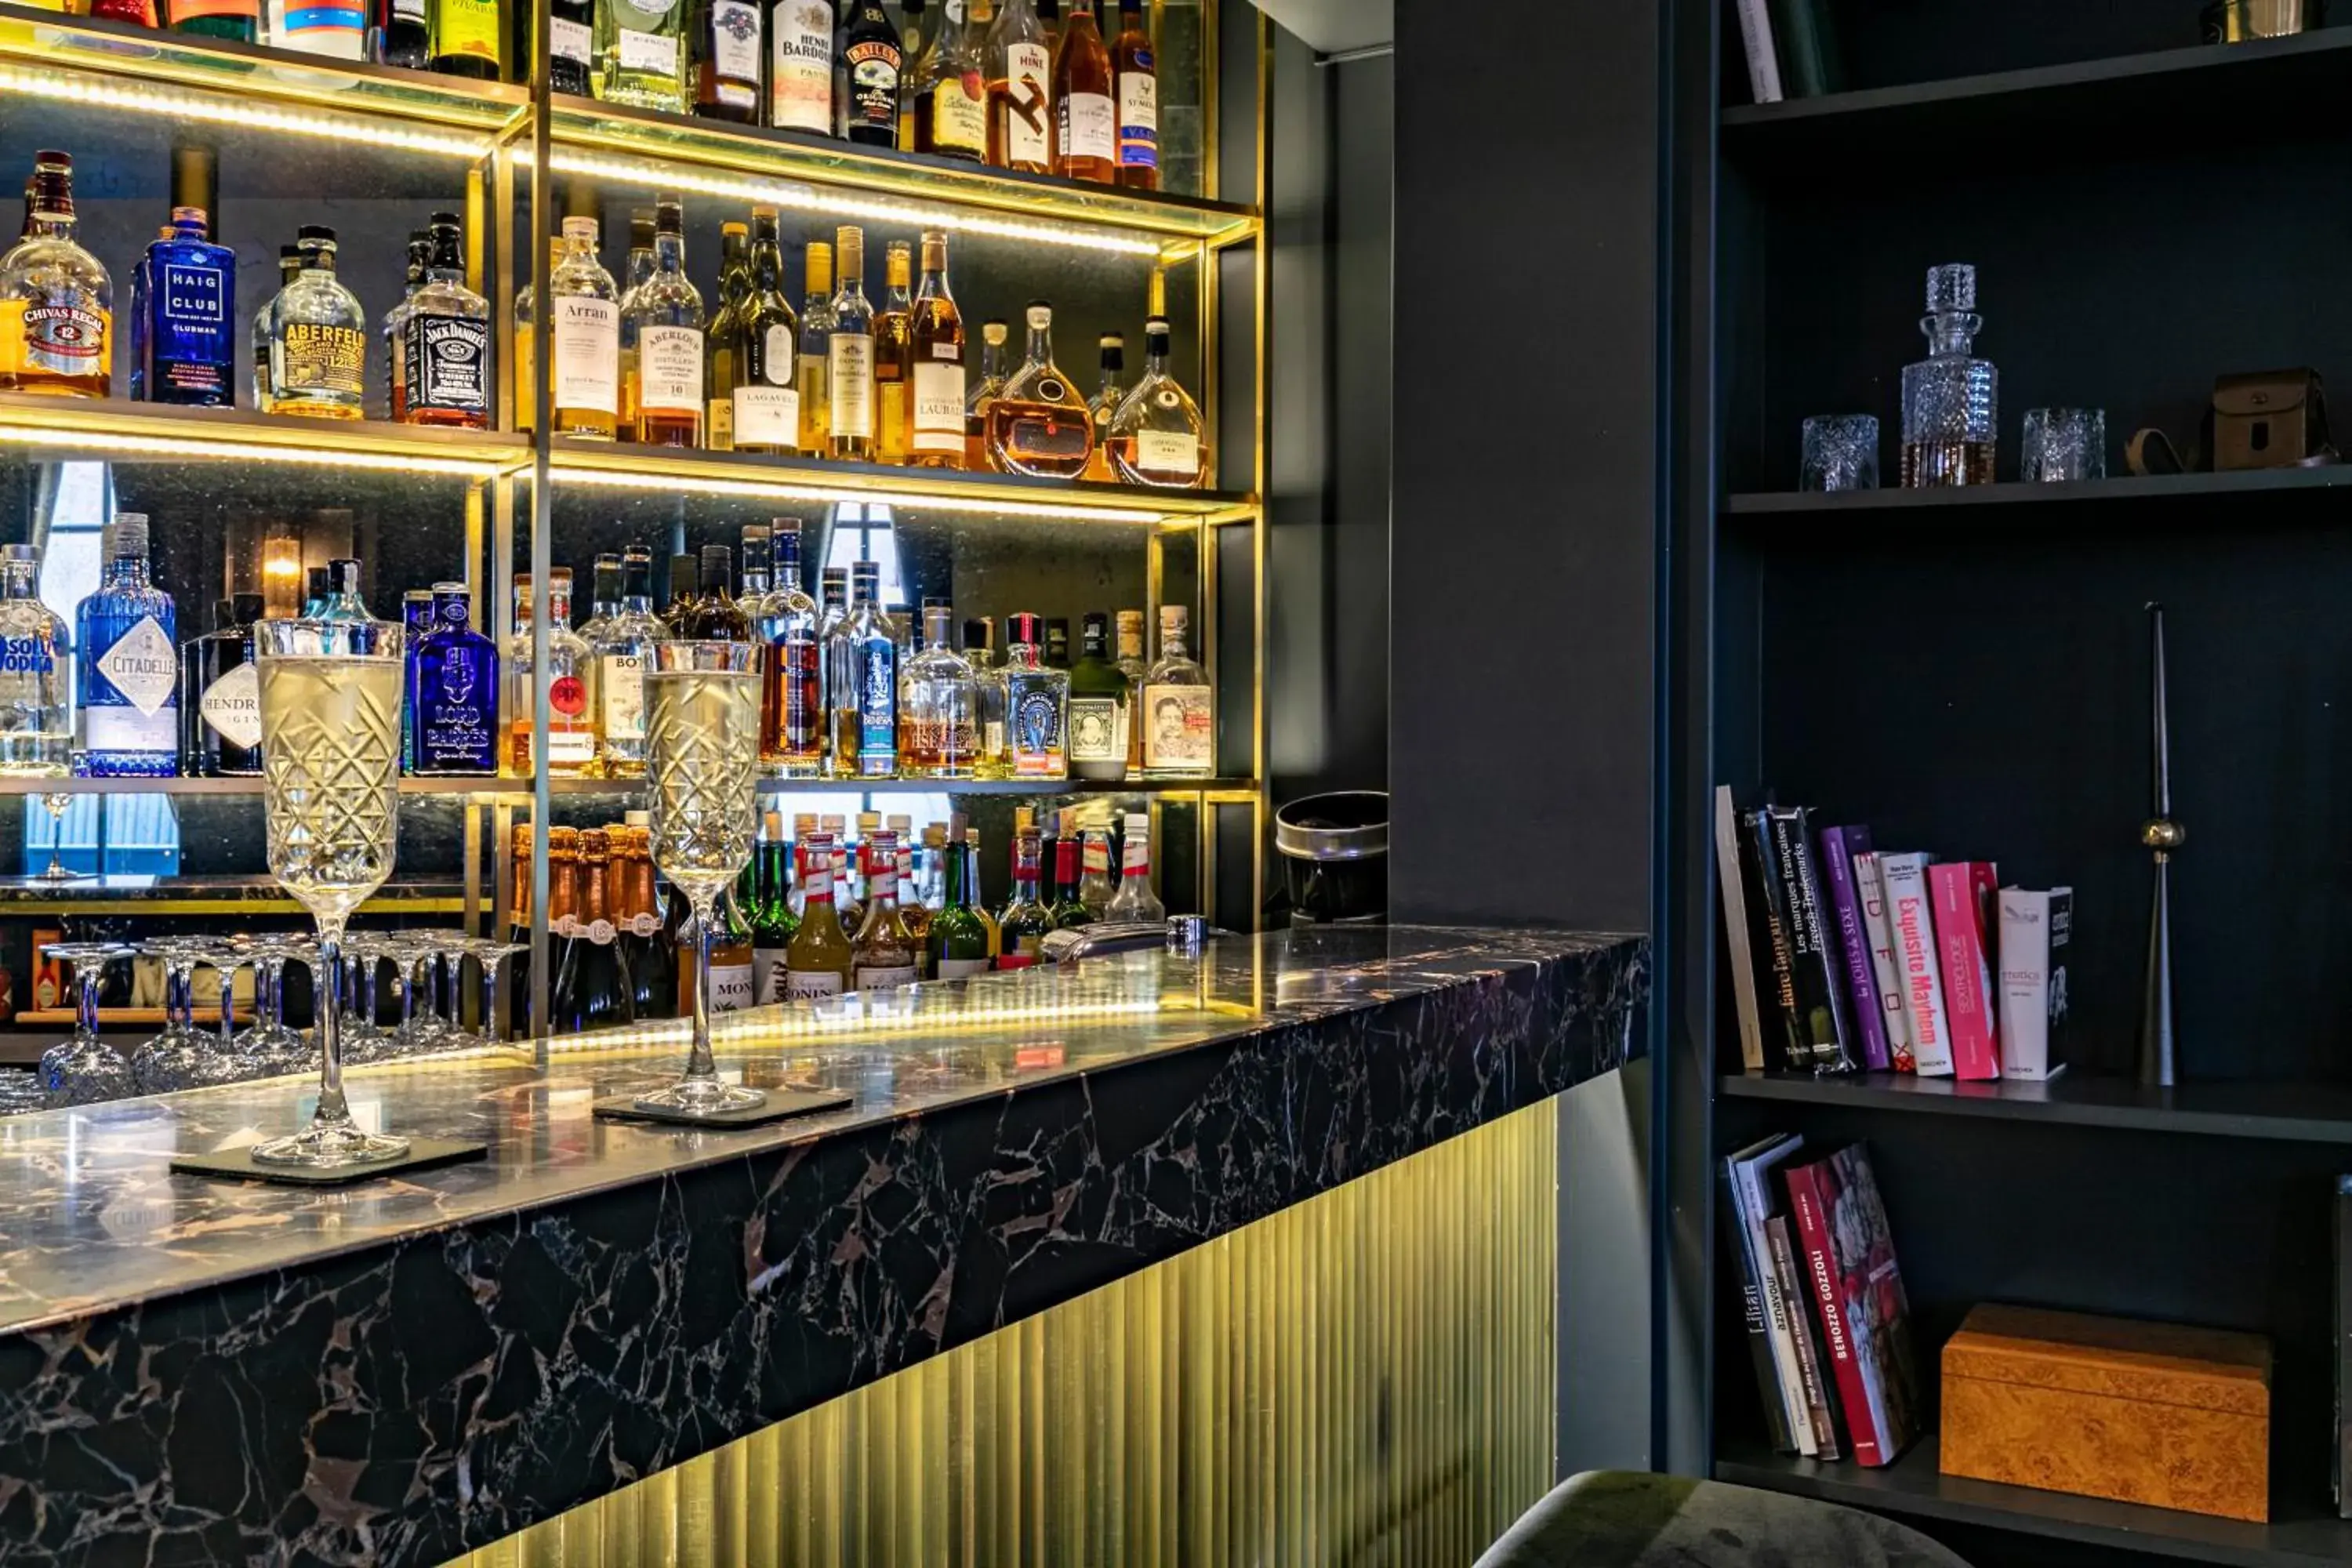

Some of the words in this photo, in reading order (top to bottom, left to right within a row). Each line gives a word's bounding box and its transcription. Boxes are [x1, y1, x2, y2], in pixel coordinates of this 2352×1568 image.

[1021, 56, 1044, 69] HINE
[172, 273, 216, 288] HAIG
[172, 297, 216, 311] CLUB
[566, 304, 608, 320] Arran
[24, 308, 68, 322] CHIVAS
[71, 309, 103, 332] REGAL
[62, 327, 75, 339] 12
[172, 325, 217, 335] CLUBMAN
[426, 325, 449, 343] JACK
[112, 656, 173, 675] CITADELLE
[1788, 880, 1804, 932] marques
[1840, 905, 1857, 935] SEXE
[1897, 897, 1924, 973] Exquisite
[1911, 973, 1936, 1045] Mayhem
[1812, 1250, 1834, 1301] GOZZOLI
[1766, 1276, 1787, 1331] aznavour
[1824, 1304, 1848, 1359] BENOZZO
